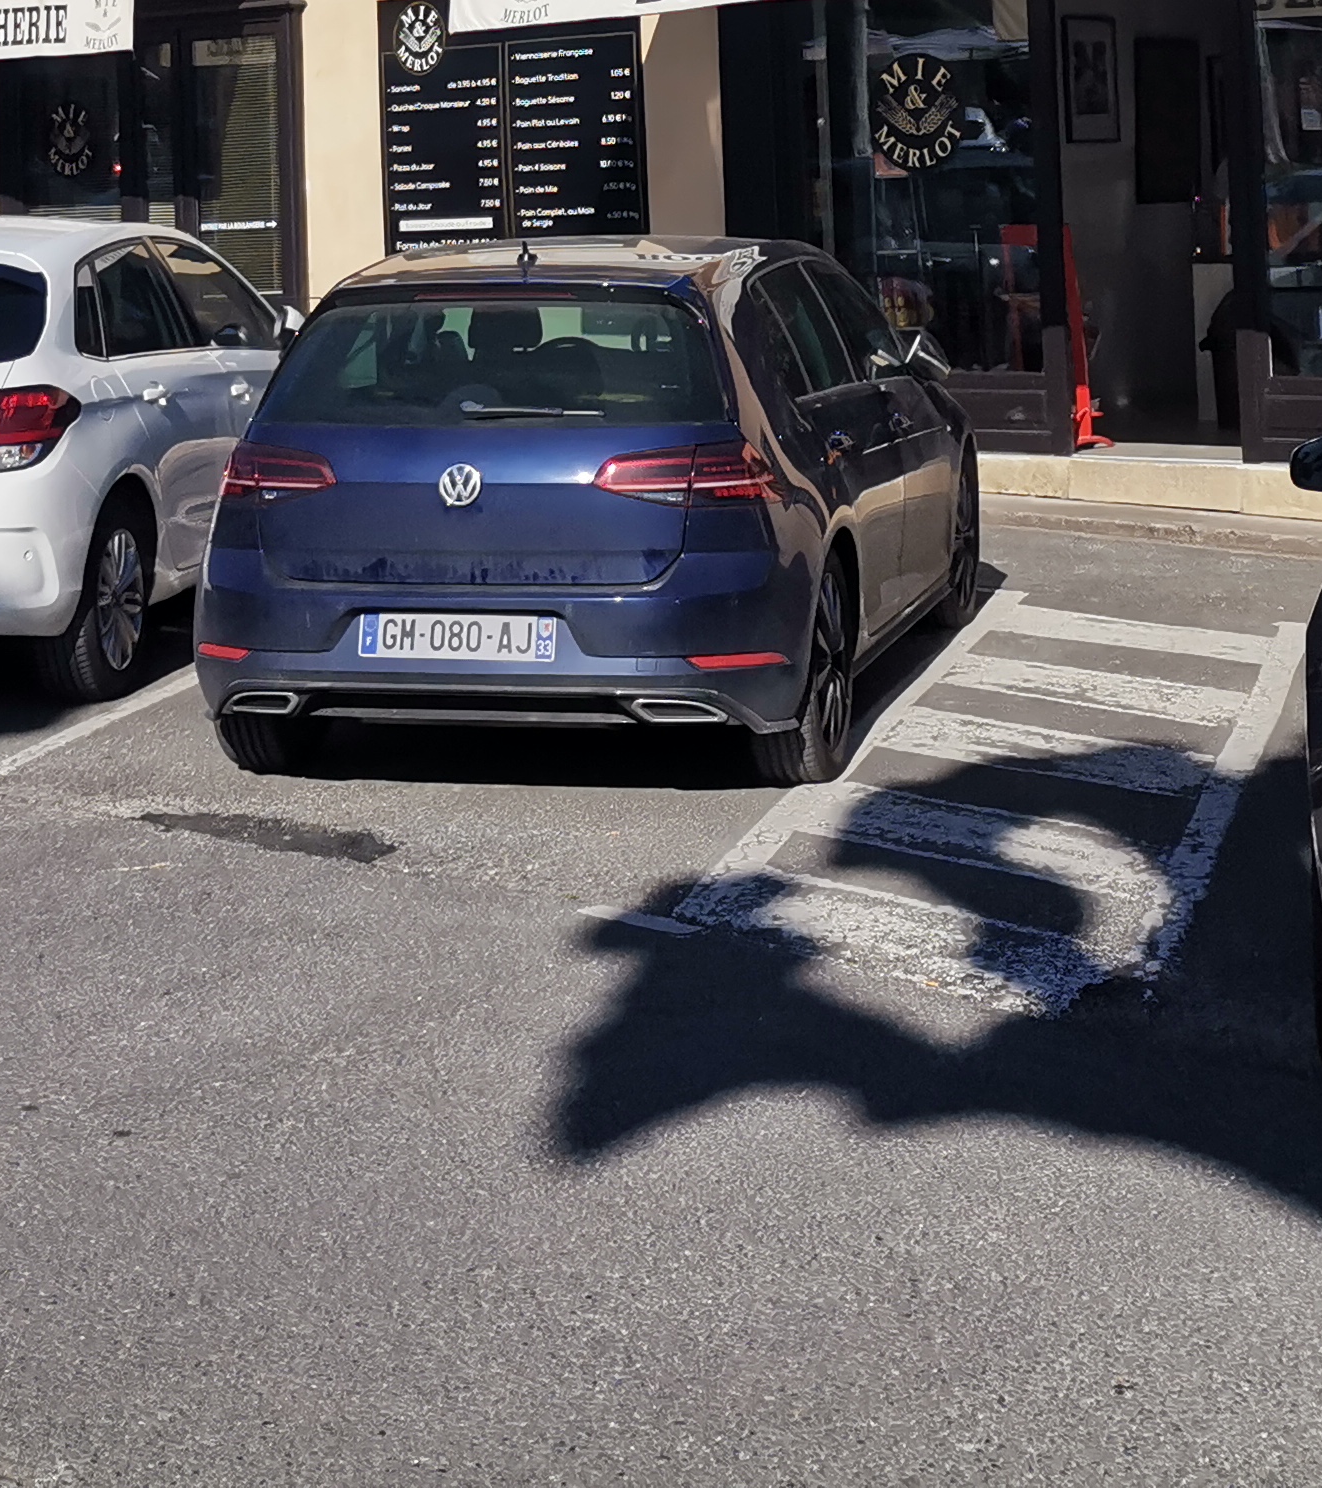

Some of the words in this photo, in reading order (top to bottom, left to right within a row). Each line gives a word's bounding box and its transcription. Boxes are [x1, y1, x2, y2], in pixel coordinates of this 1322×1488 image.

[400, 6, 438, 28] MIE
[500, 3, 549, 24] MERLOT
[413, 21, 426, 37] &
[397, 42, 443, 71] MERLOT
[879, 58, 951, 94] MIE
[905, 84, 928, 109] &
[874, 120, 962, 168] MERLOT
[365, 636, 373, 647] F
[382, 618, 533, 655] GM-080-AJ
[537, 639, 552, 656] 33
